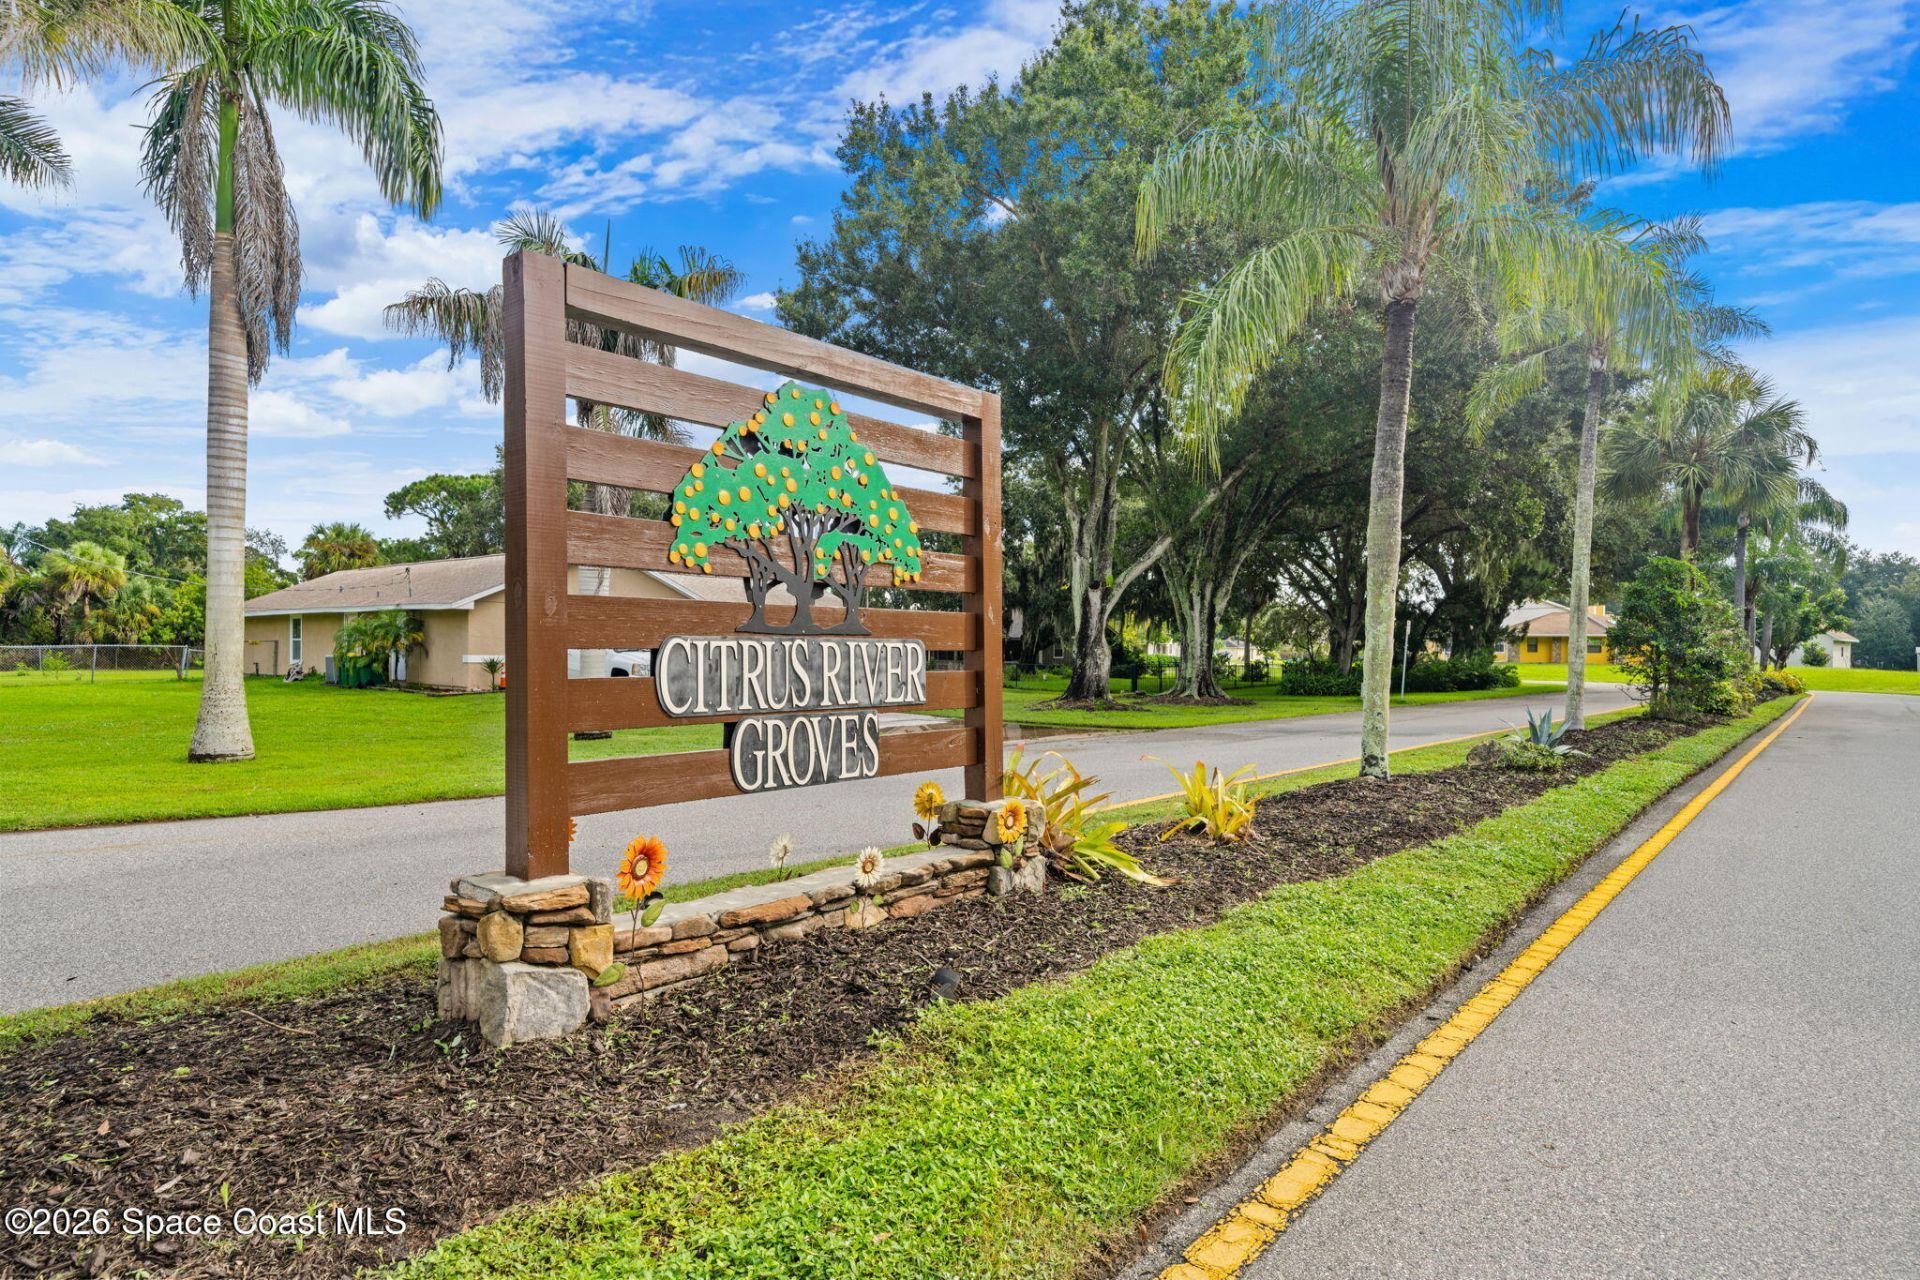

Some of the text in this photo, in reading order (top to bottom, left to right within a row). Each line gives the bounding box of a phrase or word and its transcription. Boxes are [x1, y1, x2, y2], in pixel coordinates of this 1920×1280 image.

[660, 637, 926, 715] CITRUS RIVER
[733, 713, 880, 791] GROVES
